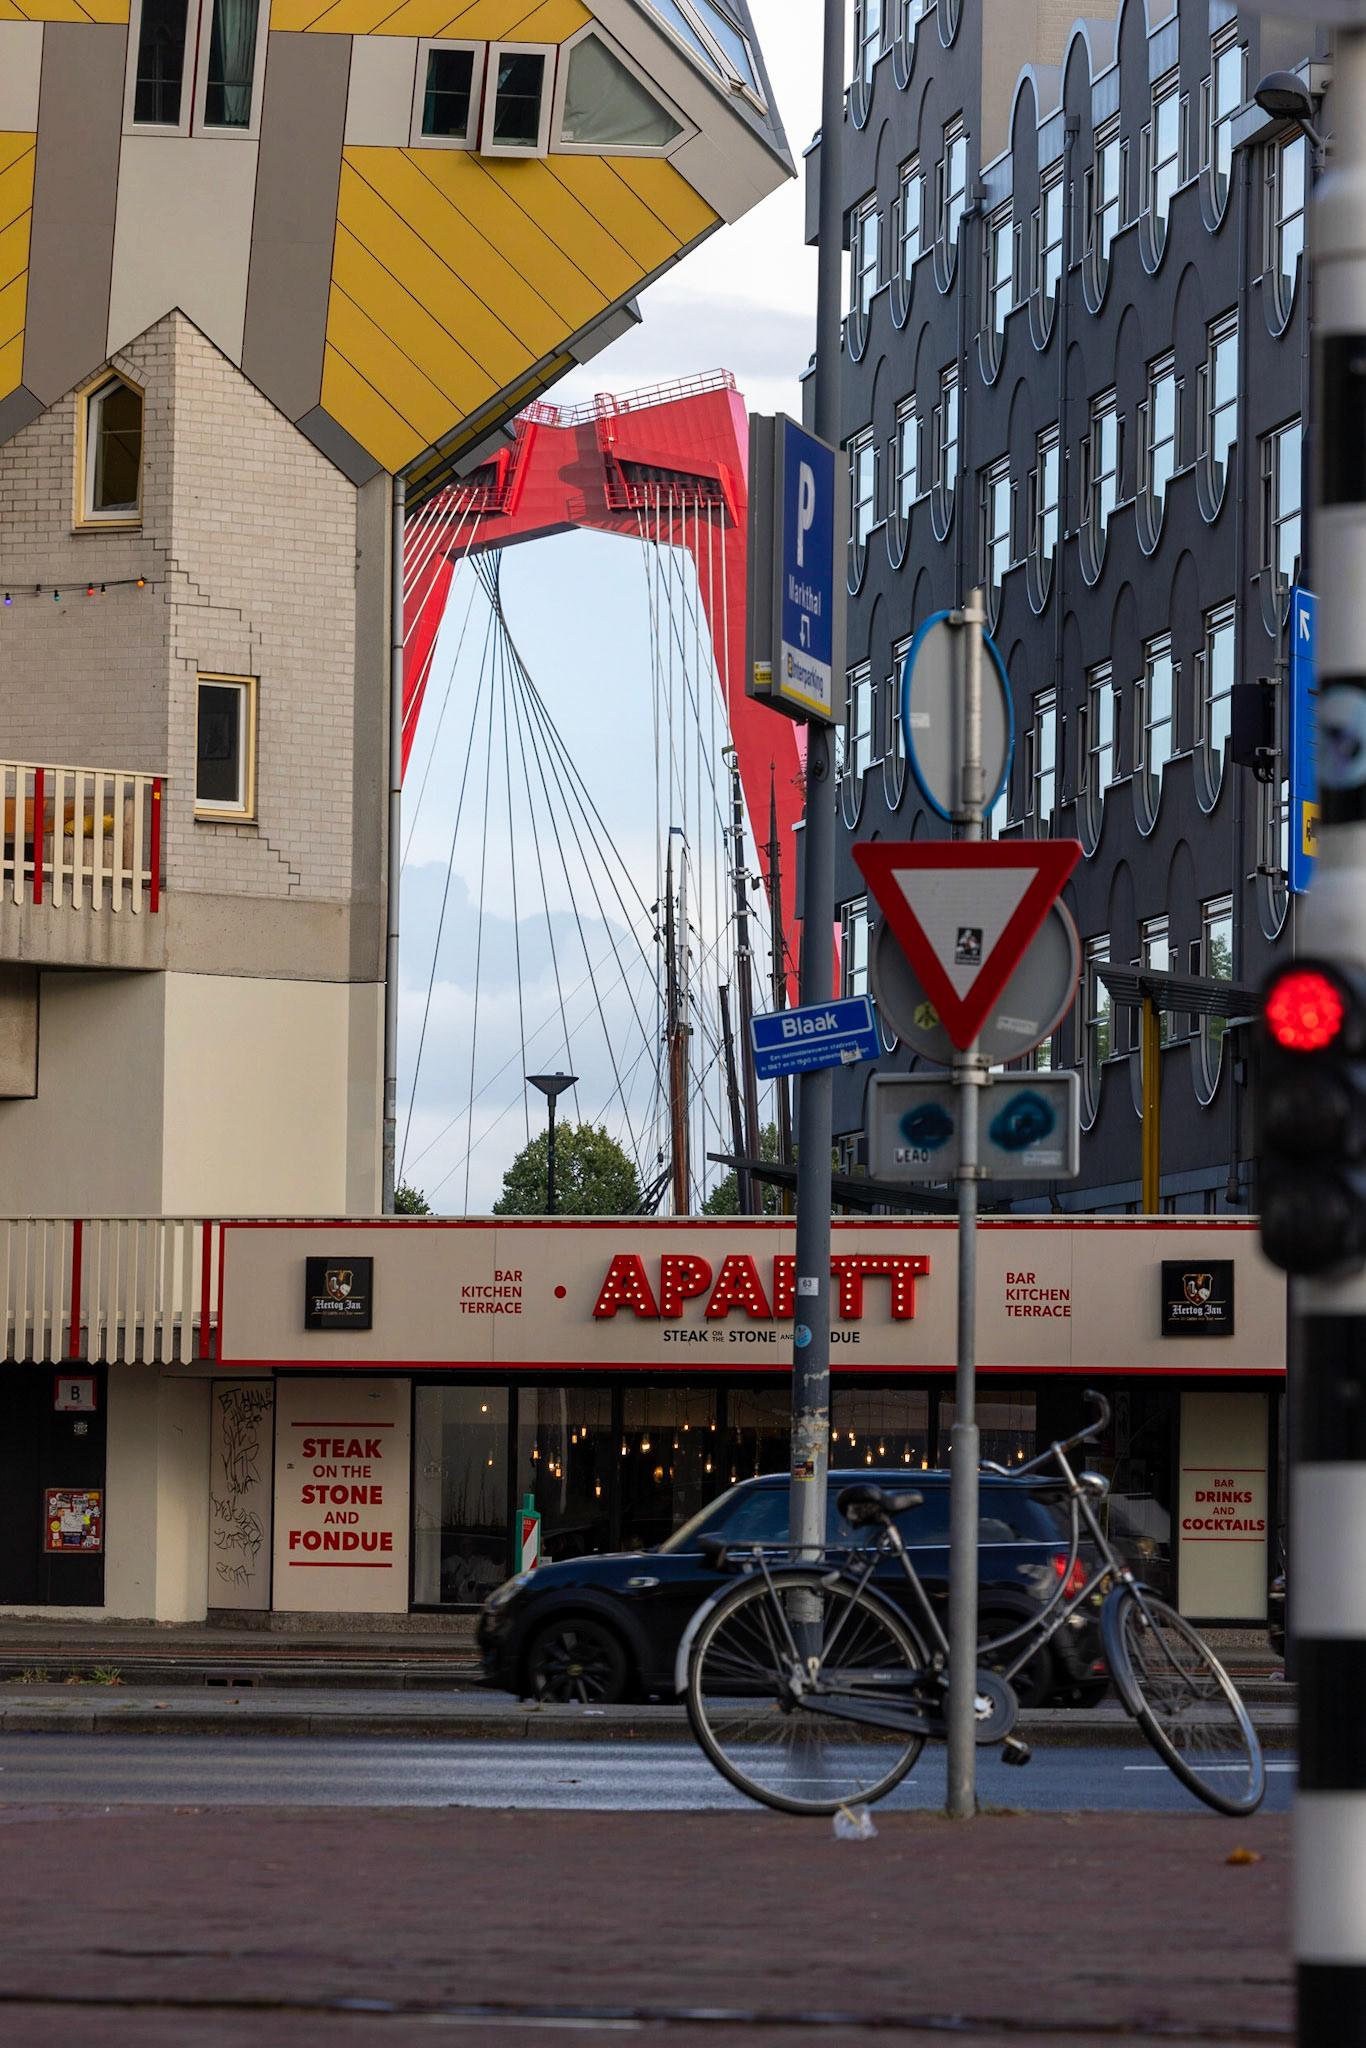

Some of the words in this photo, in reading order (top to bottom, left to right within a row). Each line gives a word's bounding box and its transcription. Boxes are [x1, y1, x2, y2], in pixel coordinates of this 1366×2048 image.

[797, 460, 815, 568] P
[789, 574, 821, 616] Markthal
[781, 1011, 838, 1038] Blaak
[494, 1270, 522, 1282] BAR
[1006, 1272, 1035, 1284] BAR
[462, 1286, 522, 1298] KITCHEN
[1006, 1289, 1070, 1301] KITCHEN
[315, 1299, 343, 1312] Hertog
[344, 1299, 361, 1312] Jan
[459, 1302, 522, 1314] TERRACE
[1005, 1305, 1071, 1317] TERRACE
[1172, 1304, 1203, 1317] Hertog
[1204, 1304, 1222, 1318] Jan
[663, 1330, 708, 1343] STEAK
[728, 1330, 777, 1343] STONE
[71, 1386, 80, 1400] B
[302, 1438, 382, 1458] STEAK
[313, 1465, 337, 1478] ON
[341, 1465, 371, 1478] THE
[1214, 1480, 1234, 1488] BAR
[301, 1485, 382, 1504] STONE
[1195, 1491, 1252, 1503] DRINKS
[1212, 1507, 1235, 1515] AND
[324, 1512, 359, 1524] AND
[1182, 1518, 1265, 1531] COCKTAILS
[289, 1531, 392, 1551] FONDUE
